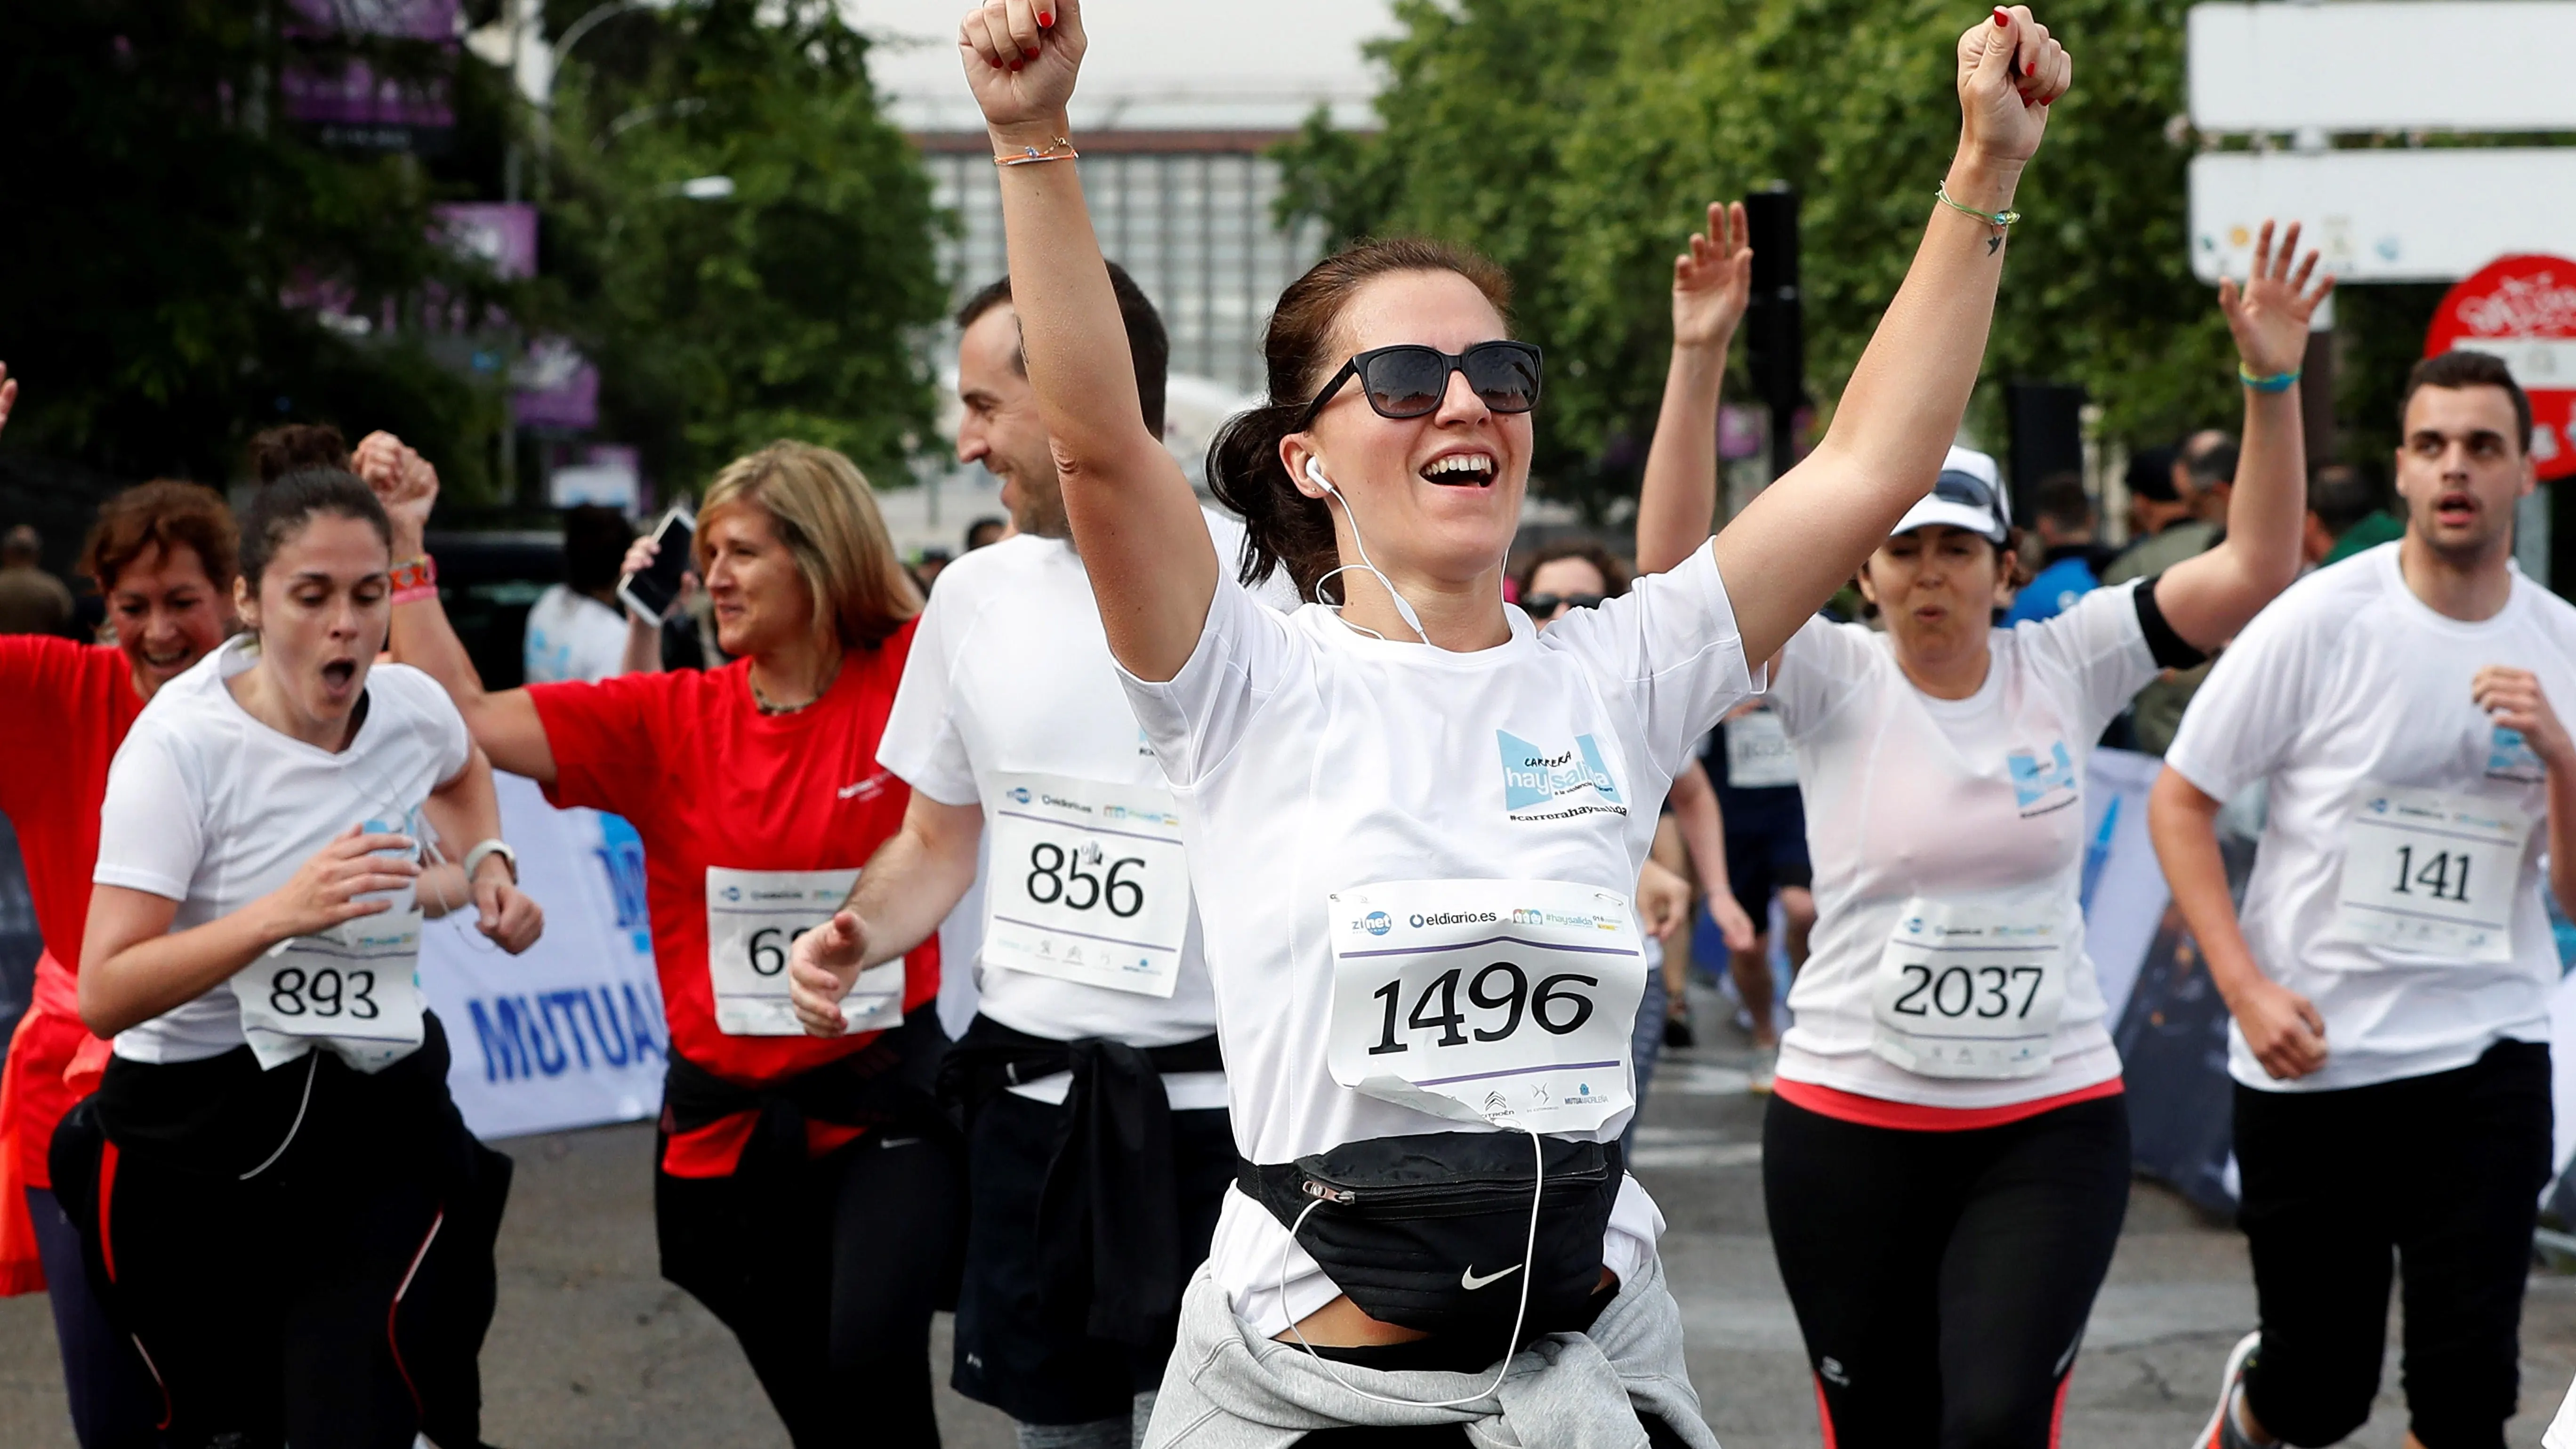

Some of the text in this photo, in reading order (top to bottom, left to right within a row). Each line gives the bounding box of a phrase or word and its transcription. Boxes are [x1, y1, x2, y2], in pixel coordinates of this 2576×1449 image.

[1505, 760, 1611, 796] haysalia
[1524, 750, 1571, 768] CARRERA
[1026, 842, 1146, 919] 856
[2391, 844, 2471, 904] 141
[1426, 911, 1497, 926] eldiario.es
[749, 926, 809, 976] 6
[270, 966, 379, 1020] 893
[1368, 961, 1599, 1055] 1496
[1893, 964, 2044, 1020] 2037
